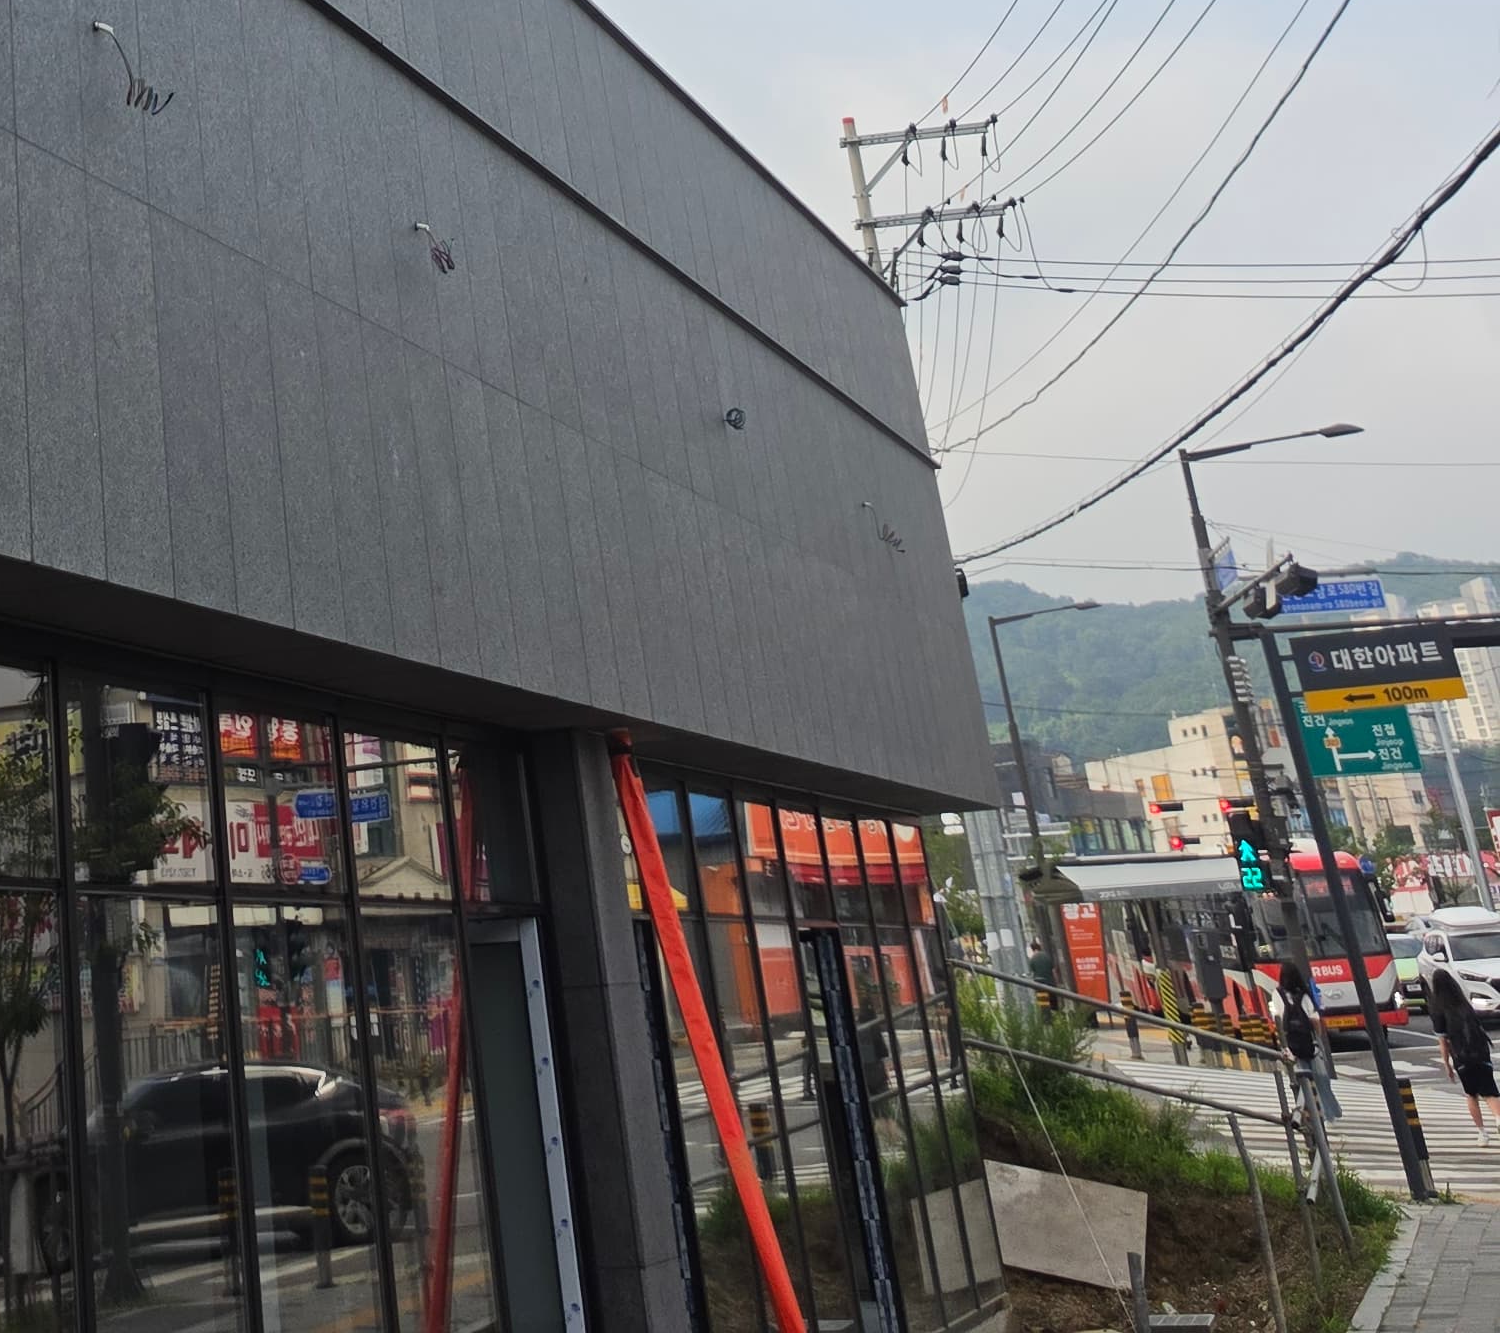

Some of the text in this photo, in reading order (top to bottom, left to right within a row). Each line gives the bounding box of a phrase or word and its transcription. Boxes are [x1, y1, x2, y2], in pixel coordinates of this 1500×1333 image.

[1330, 640, 1444, 671] 대한아파트
[1383, 686, 1429, 702] 100m
[1241, 867, 1264, 890] 22
[1322, 964, 1344, 976] BUS
